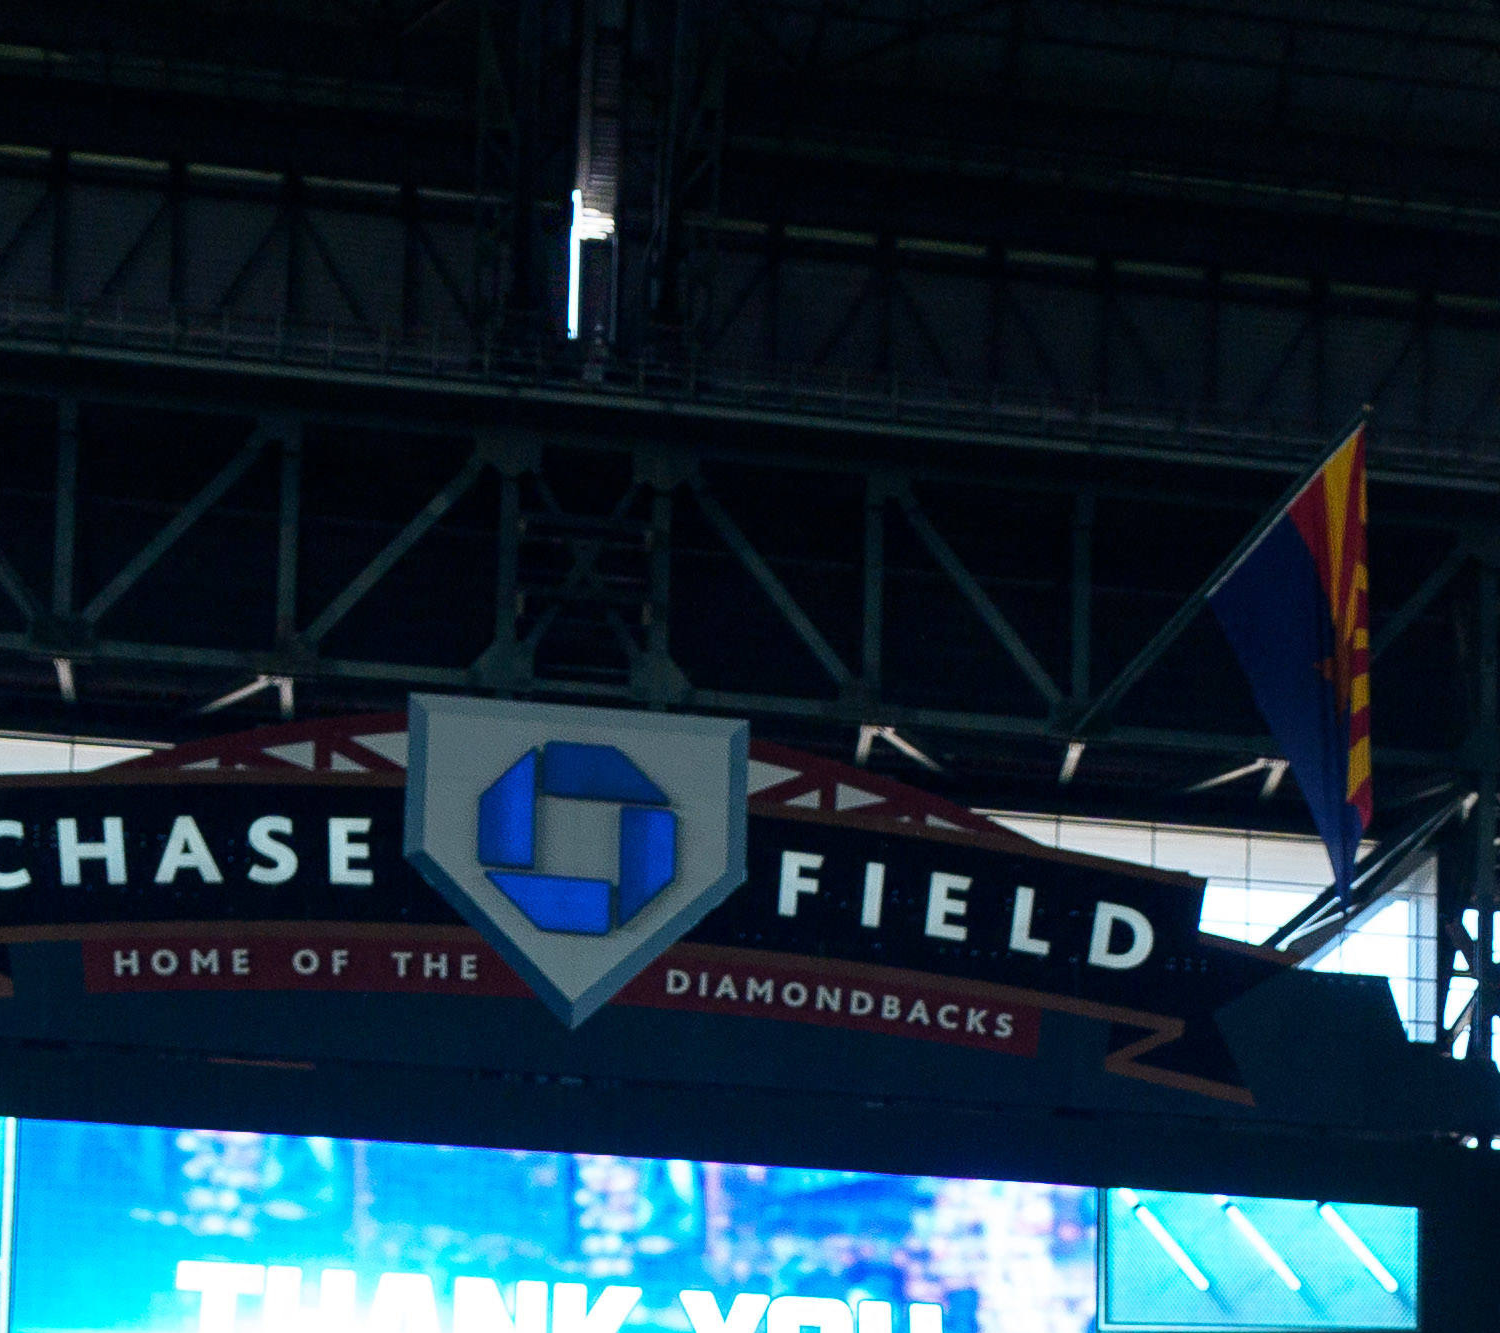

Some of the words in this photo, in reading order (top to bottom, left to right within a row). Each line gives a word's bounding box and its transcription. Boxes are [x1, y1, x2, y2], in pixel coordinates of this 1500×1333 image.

[777, 849, 1157, 969] FIELD
[113, 947, 252, 980] HOME
[291, 947, 349, 976] OF
[392, 948, 480, 981] THE
[664, 966, 1016, 1040] DIAMONDBACKS
